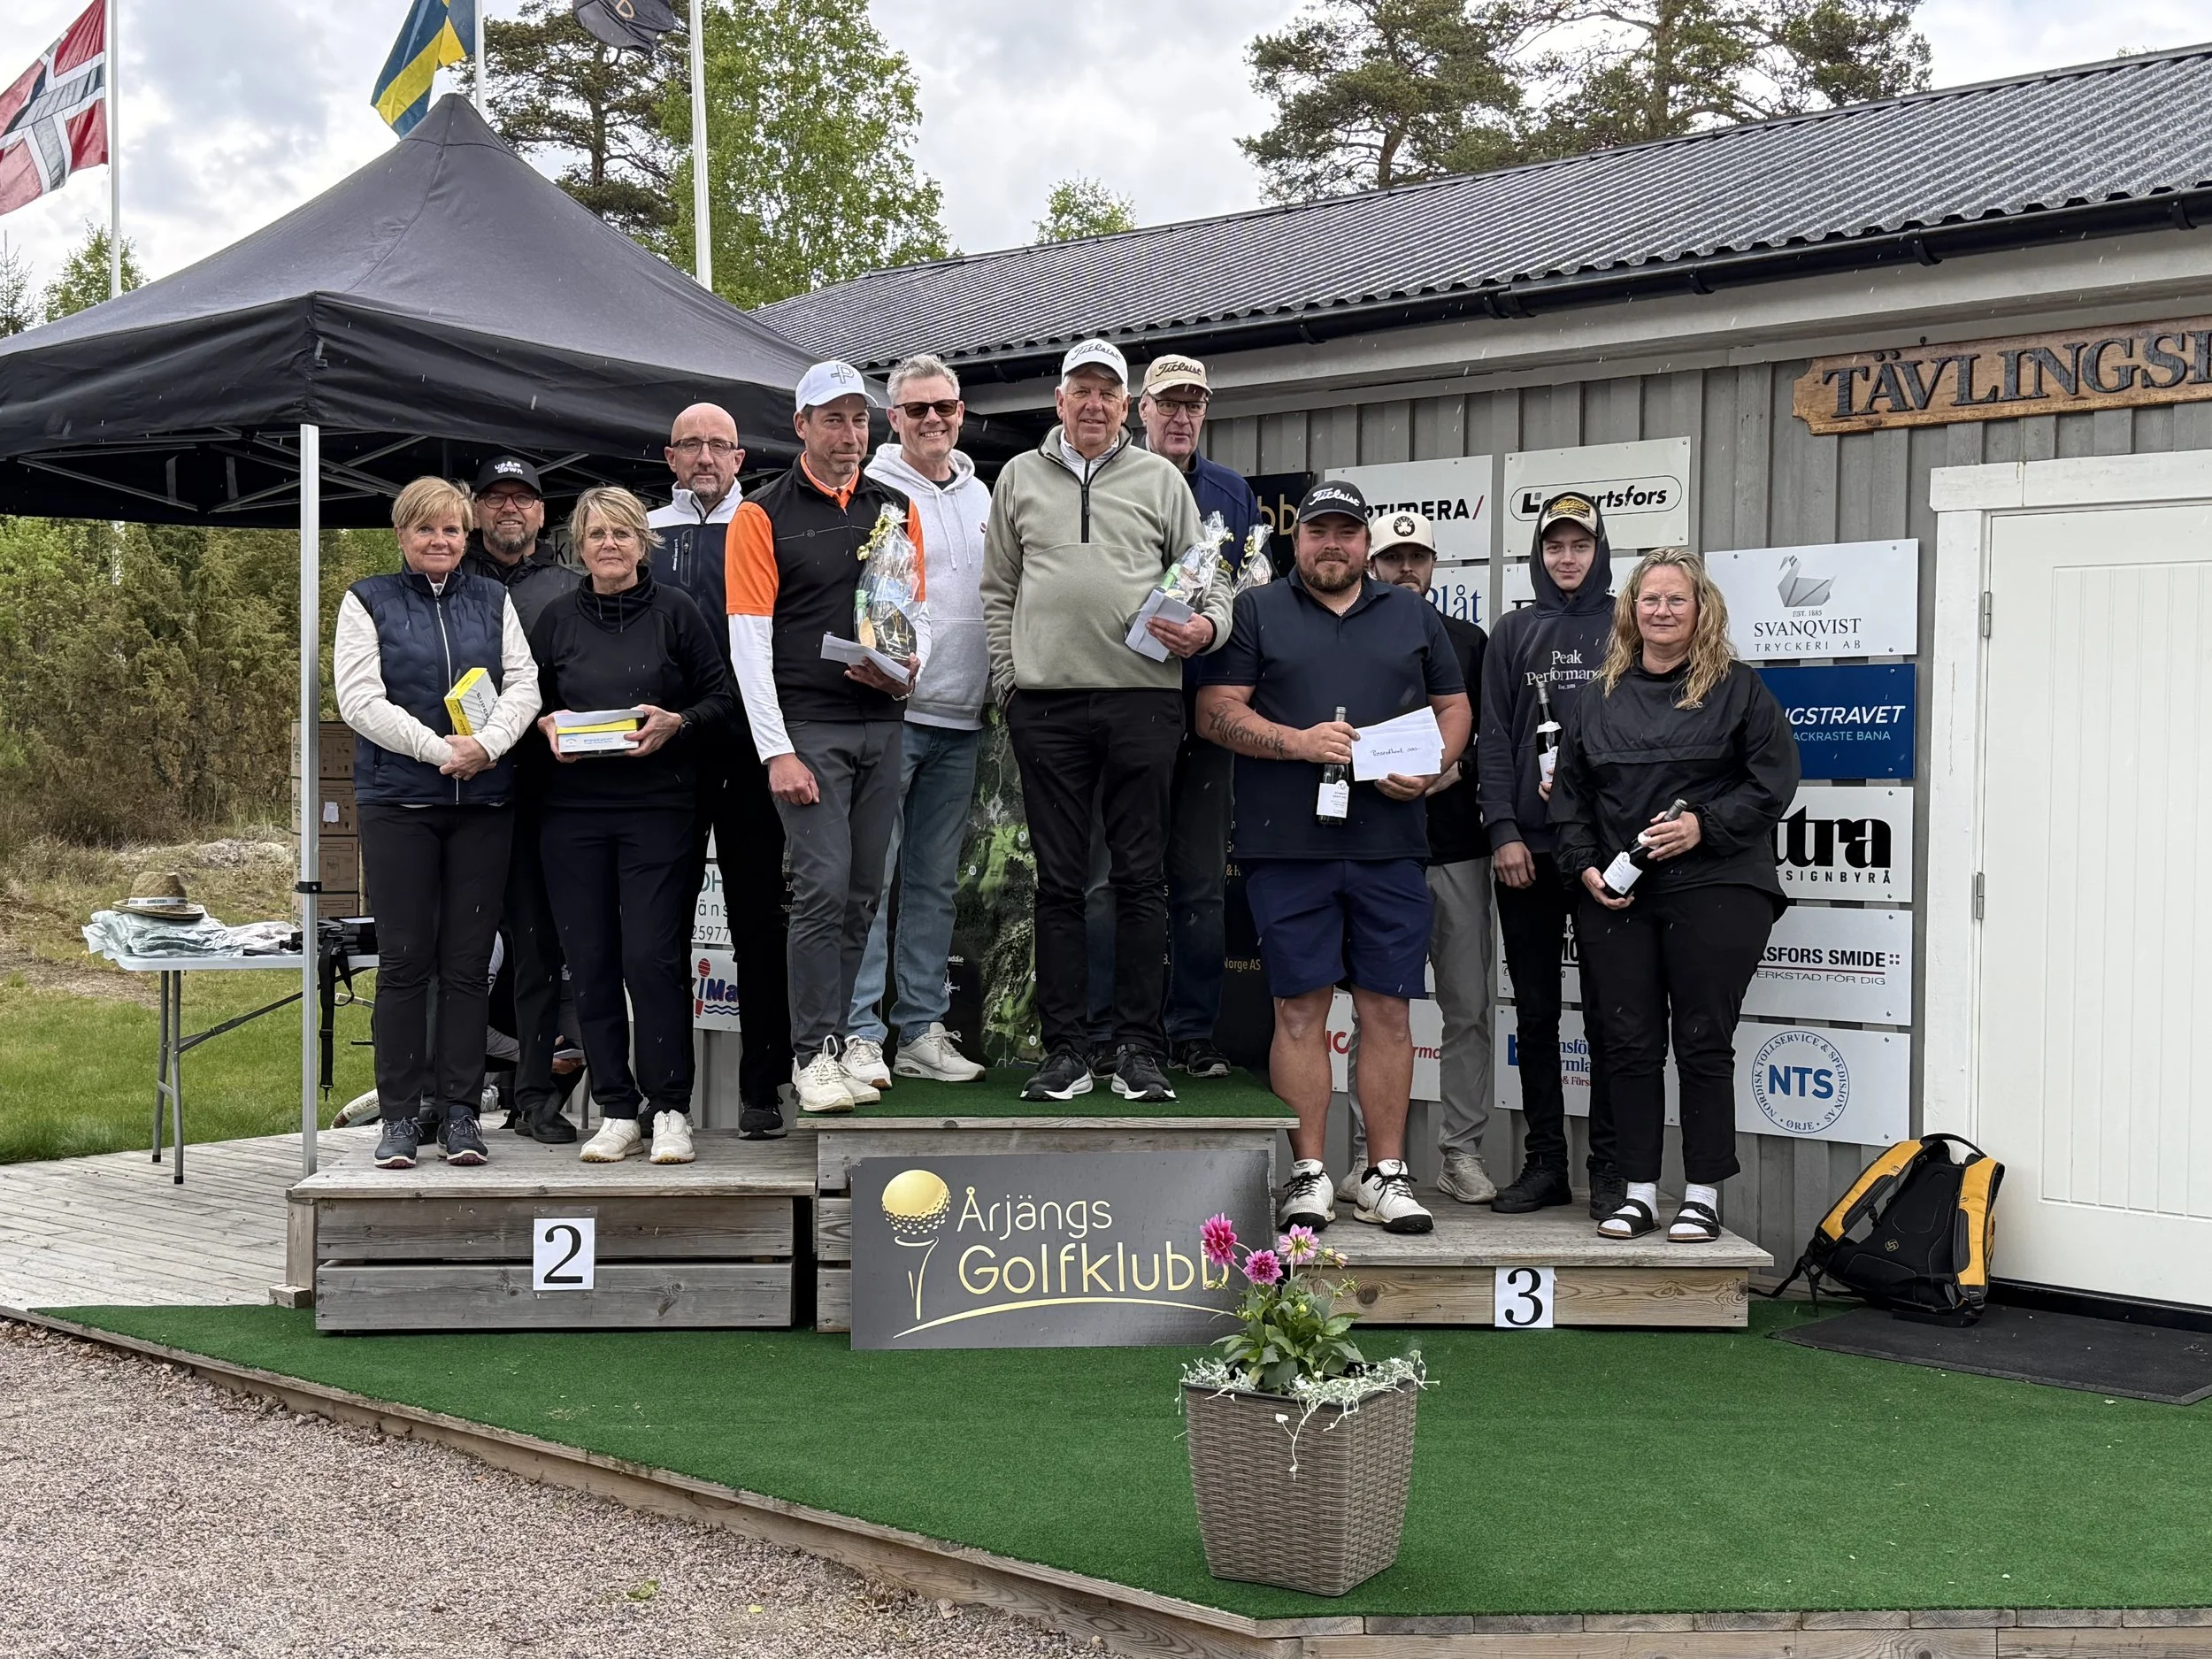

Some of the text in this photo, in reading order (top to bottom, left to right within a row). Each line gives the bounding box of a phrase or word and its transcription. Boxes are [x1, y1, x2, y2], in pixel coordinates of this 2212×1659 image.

[1155, 360, 1202, 378] Titleist
[1308, 487, 1361, 508] Titleist
[1754, 618, 1862, 638] SVANQVIST
[1755, 640, 1861, 652] TRYCKERI AB
[1551, 649, 1583, 665] Peak
[1856, 731, 1892, 741] BANA
[1249, 959, 1261, 970] AS
[1828, 949, 1886, 967] SMIDE
[1756, 970, 1821, 981] ERKSTAD
[1826, 974, 1855, 983] FÖR
[1756, 1033, 1819, 1067] TOLLSERVICE
[1821, 1044, 1829, 1053] &
[1769, 1064, 1834, 1099] NTS
[1828, 1051, 1847, 1110] SPEDISJON
[1755, 1070, 1777, 1118] NORDISK
[1786, 1119, 1815, 1130] ØRJE
[956, 1186, 1112, 1240] Årjängs
[543, 1225, 584, 1284] 2
[1504, 1267, 1544, 1326] 3
